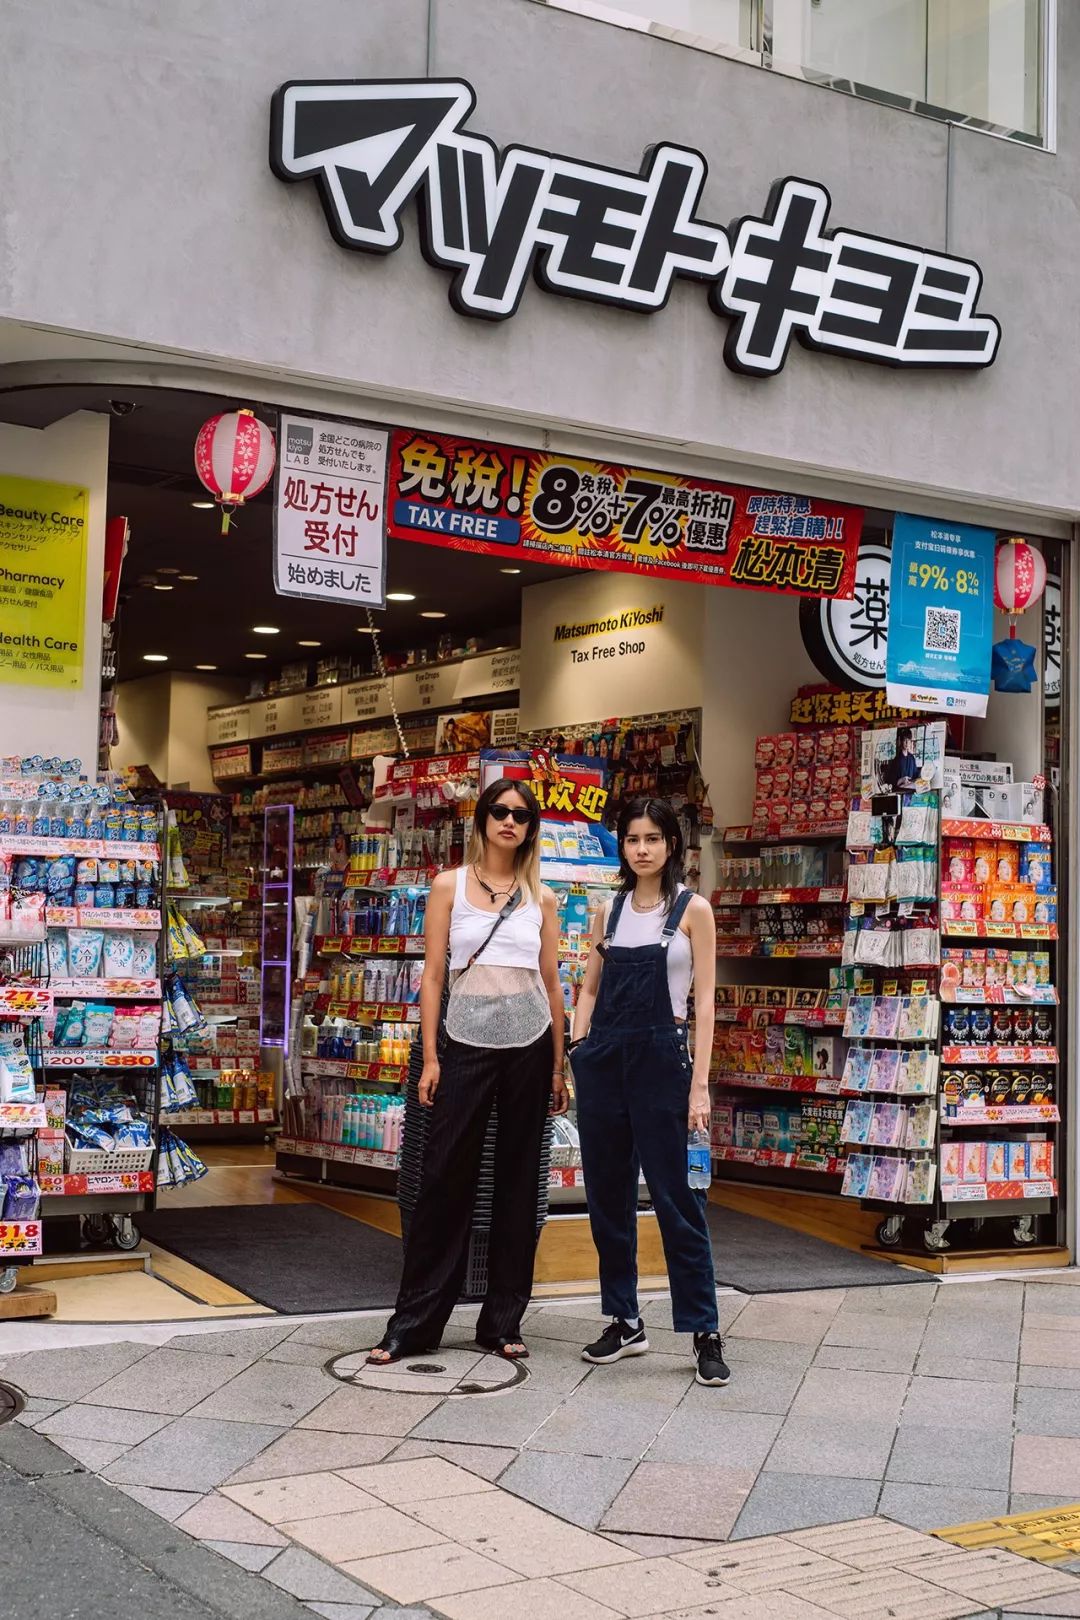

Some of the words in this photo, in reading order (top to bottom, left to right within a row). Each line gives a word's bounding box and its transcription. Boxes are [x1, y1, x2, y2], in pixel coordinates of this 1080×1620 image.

[284, 88, 995, 366] マツモトキヨシ
[319, 432, 382, 451] 全国どこの病院の
[318, 444, 365, 460] 処方せんでも
[283, 476, 379, 522] 処方せん
[661, 486, 690, 509] 最高
[690, 491, 733, 520] 折扣
[746, 496, 812, 515] 限時特惠
[51, 511, 84, 527] Care
[408, 505, 447, 529] TAX
[449, 513, 499, 538] FREE
[303, 519, 359, 557] 受付
[685, 521, 728, 551] 優惠
[654, 557, 681, 568] Facebook
[731, 537, 844, 590] 松本清
[287, 562, 372, 593] 始めました
[918, 563, 949, 591] 9%
[955, 569, 979, 593] 8%
[848, 576, 890, 651] 薬
[554, 618, 618, 641] Matsumoto
[619, 606, 664, 629] KiYoshi
[44, 636, 78, 652] Care
[570, 650, 589, 663] Tax
[592, 646, 616, 660] Free
[618, 641, 646, 656] Shop
[852, 652, 886, 670] 処方せん
[424, 671, 440, 681] Drops
[79, 948, 92, 963] 冷
[113, 941, 126, 955] 冷
[135, 948, 148, 963] 冷
[5, 990, 51, 1002] 275
[50, 1057, 85, 1065] 200
[104, 1055, 155, 1066] 380
[87, 1176, 115, 1185] ヒヤロン
[120, 1174, 138, 1182] 139
[5, 1241, 38, 1249] 343
